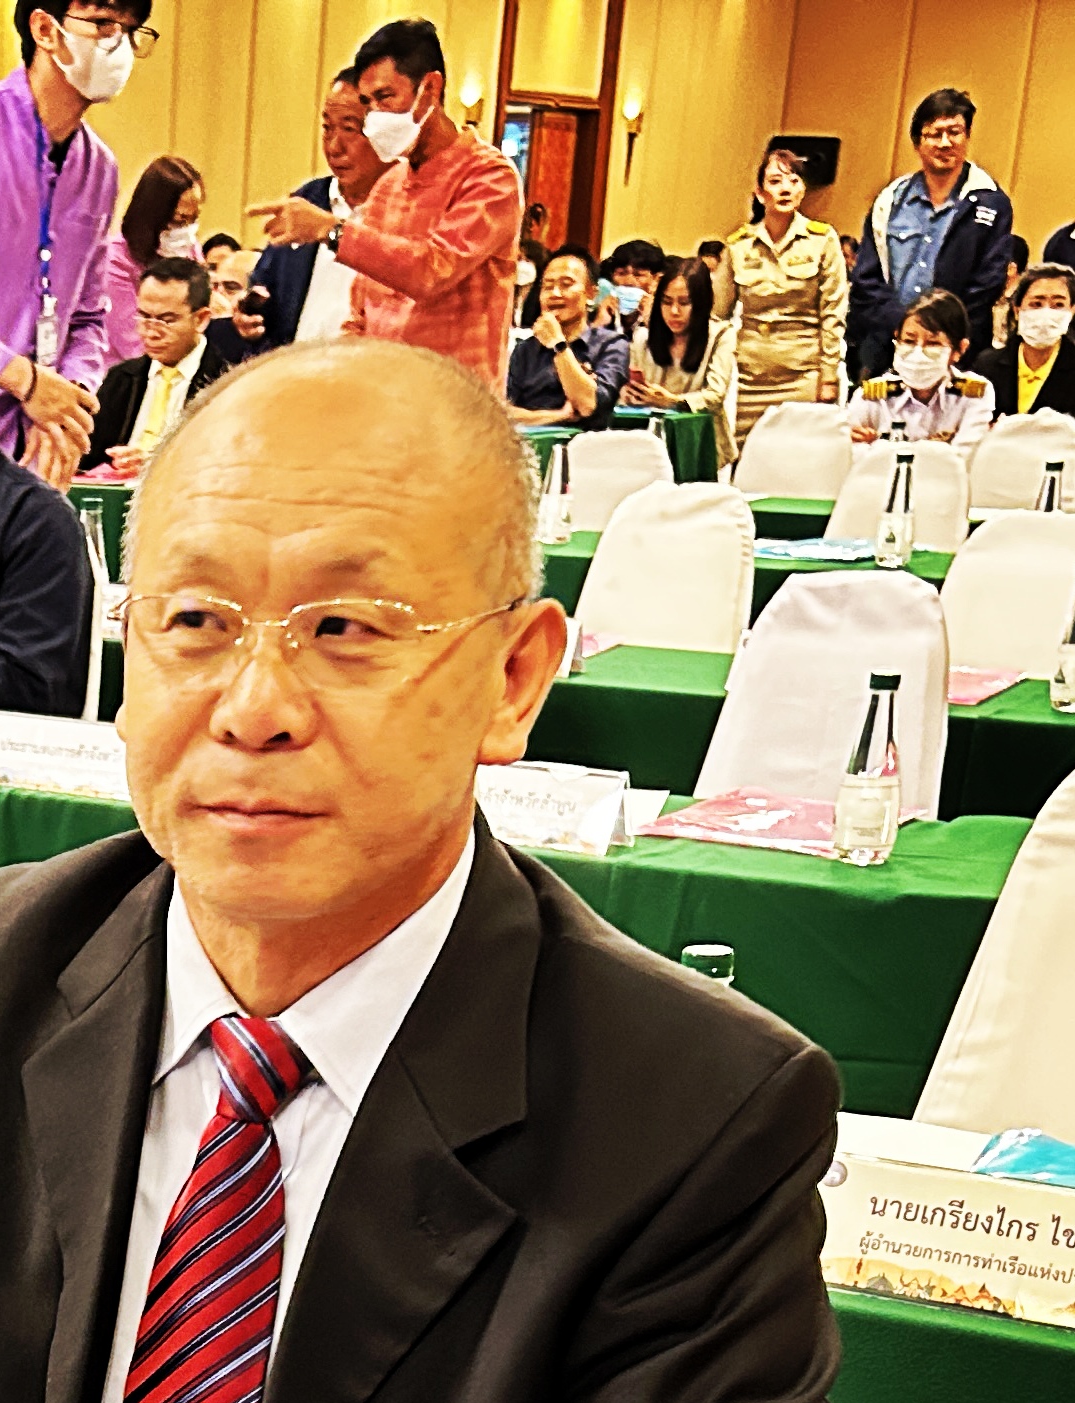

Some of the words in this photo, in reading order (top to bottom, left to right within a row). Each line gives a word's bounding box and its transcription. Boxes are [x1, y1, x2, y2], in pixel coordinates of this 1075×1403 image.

[870, 1196, 1040, 1242] นายเกรียงไกร
[859, 1230, 1075, 1284] ผู้อำนวยการการท่าเรือแห่งป
